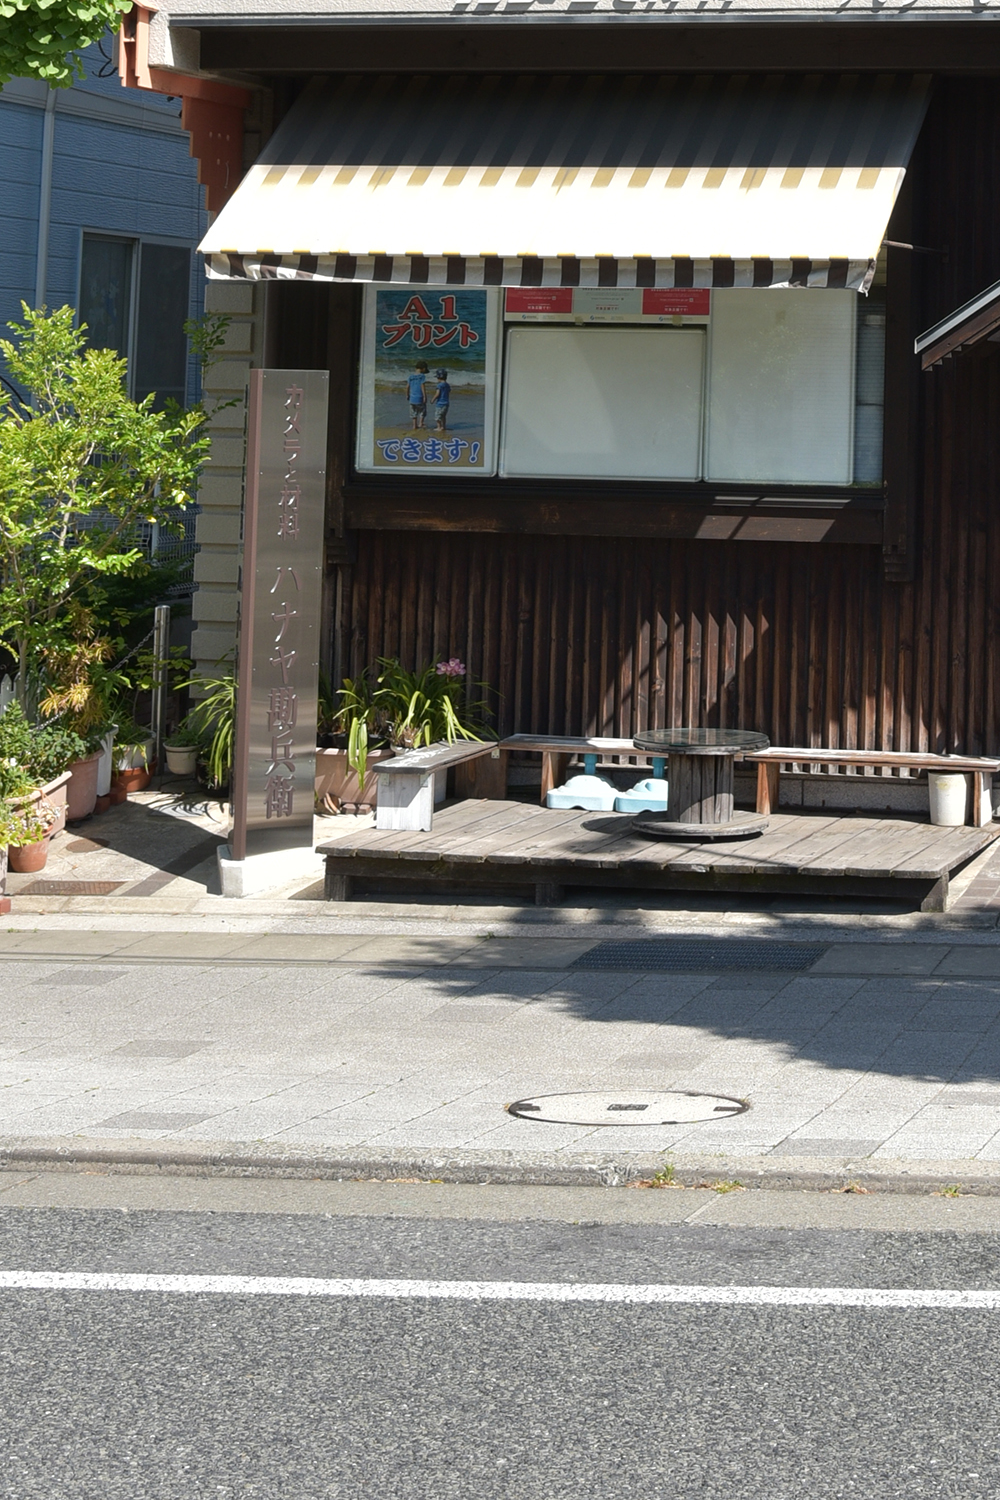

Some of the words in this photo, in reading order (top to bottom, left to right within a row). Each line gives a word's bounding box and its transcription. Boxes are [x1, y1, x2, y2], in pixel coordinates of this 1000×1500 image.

[382, 322, 479, 348] プリント
[277, 384, 303, 541] カメラと材料
[377, 437, 480, 464] できます!
[264, 565, 300, 819] ハナヤ勘兵衛
